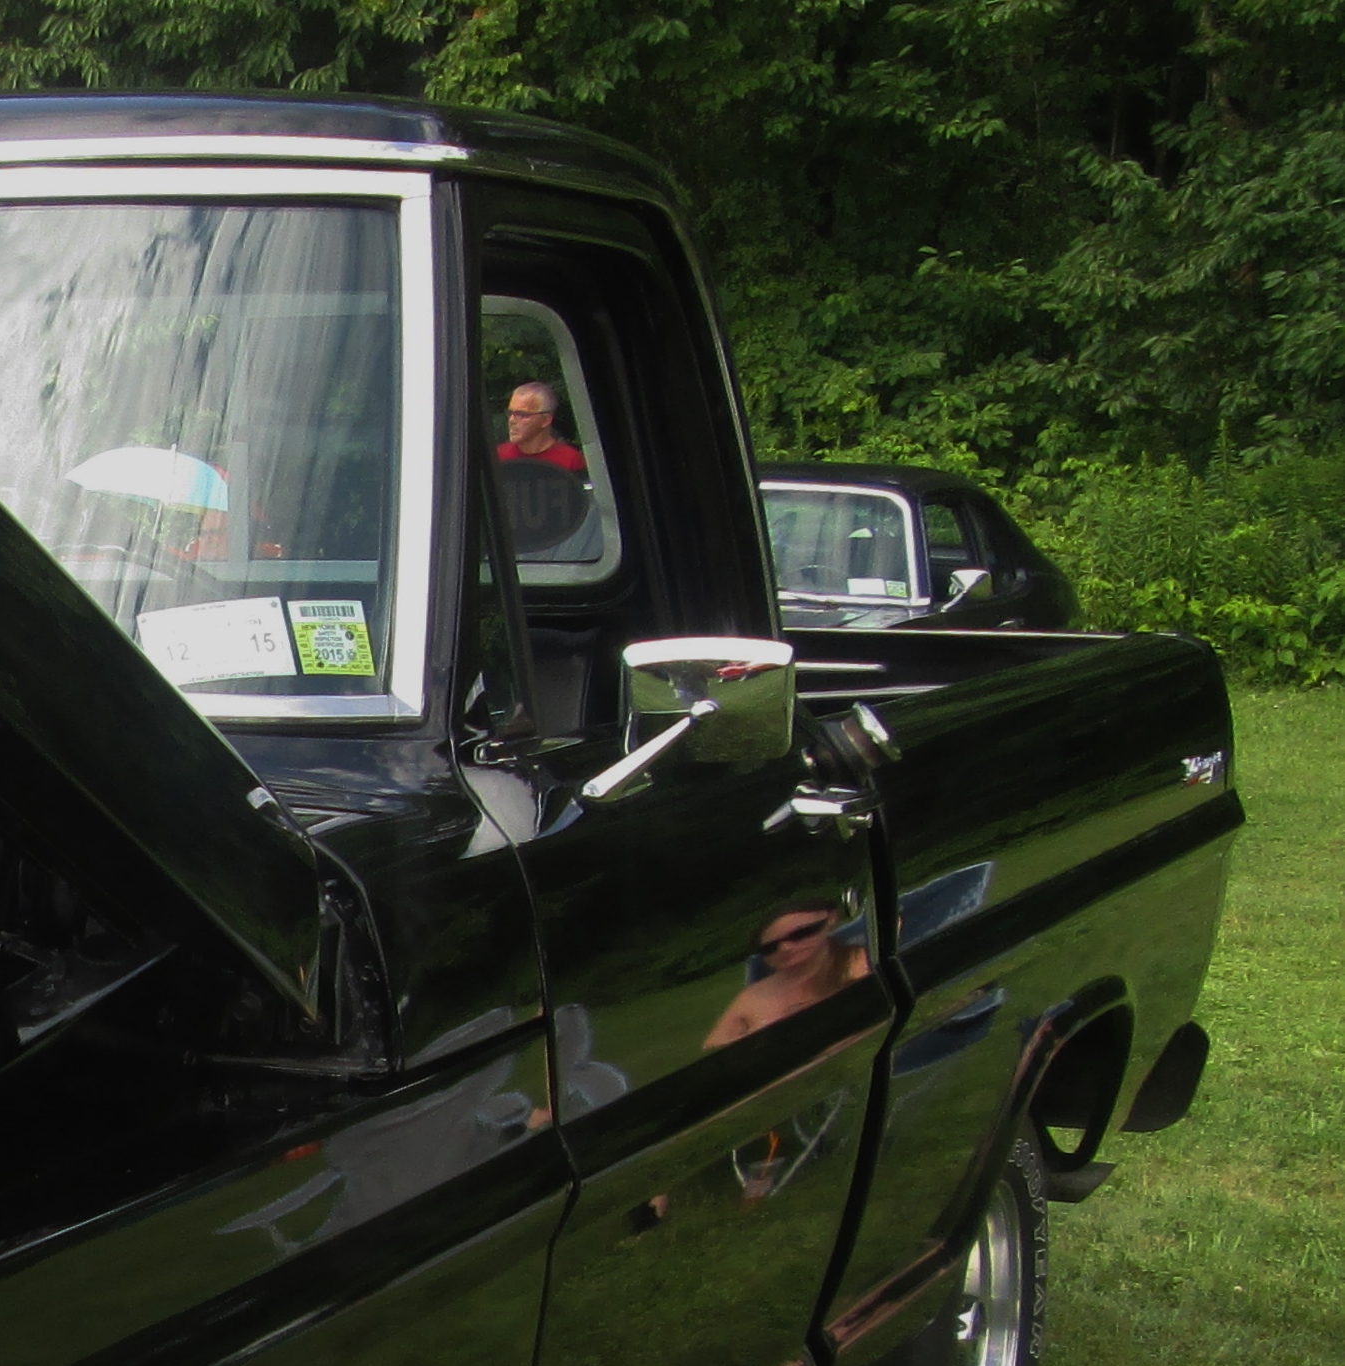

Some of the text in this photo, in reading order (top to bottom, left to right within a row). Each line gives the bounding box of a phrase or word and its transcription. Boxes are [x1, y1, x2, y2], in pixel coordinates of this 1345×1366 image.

[166, 633, 276, 661] 12 15
[313, 648, 345, 661] 2015
